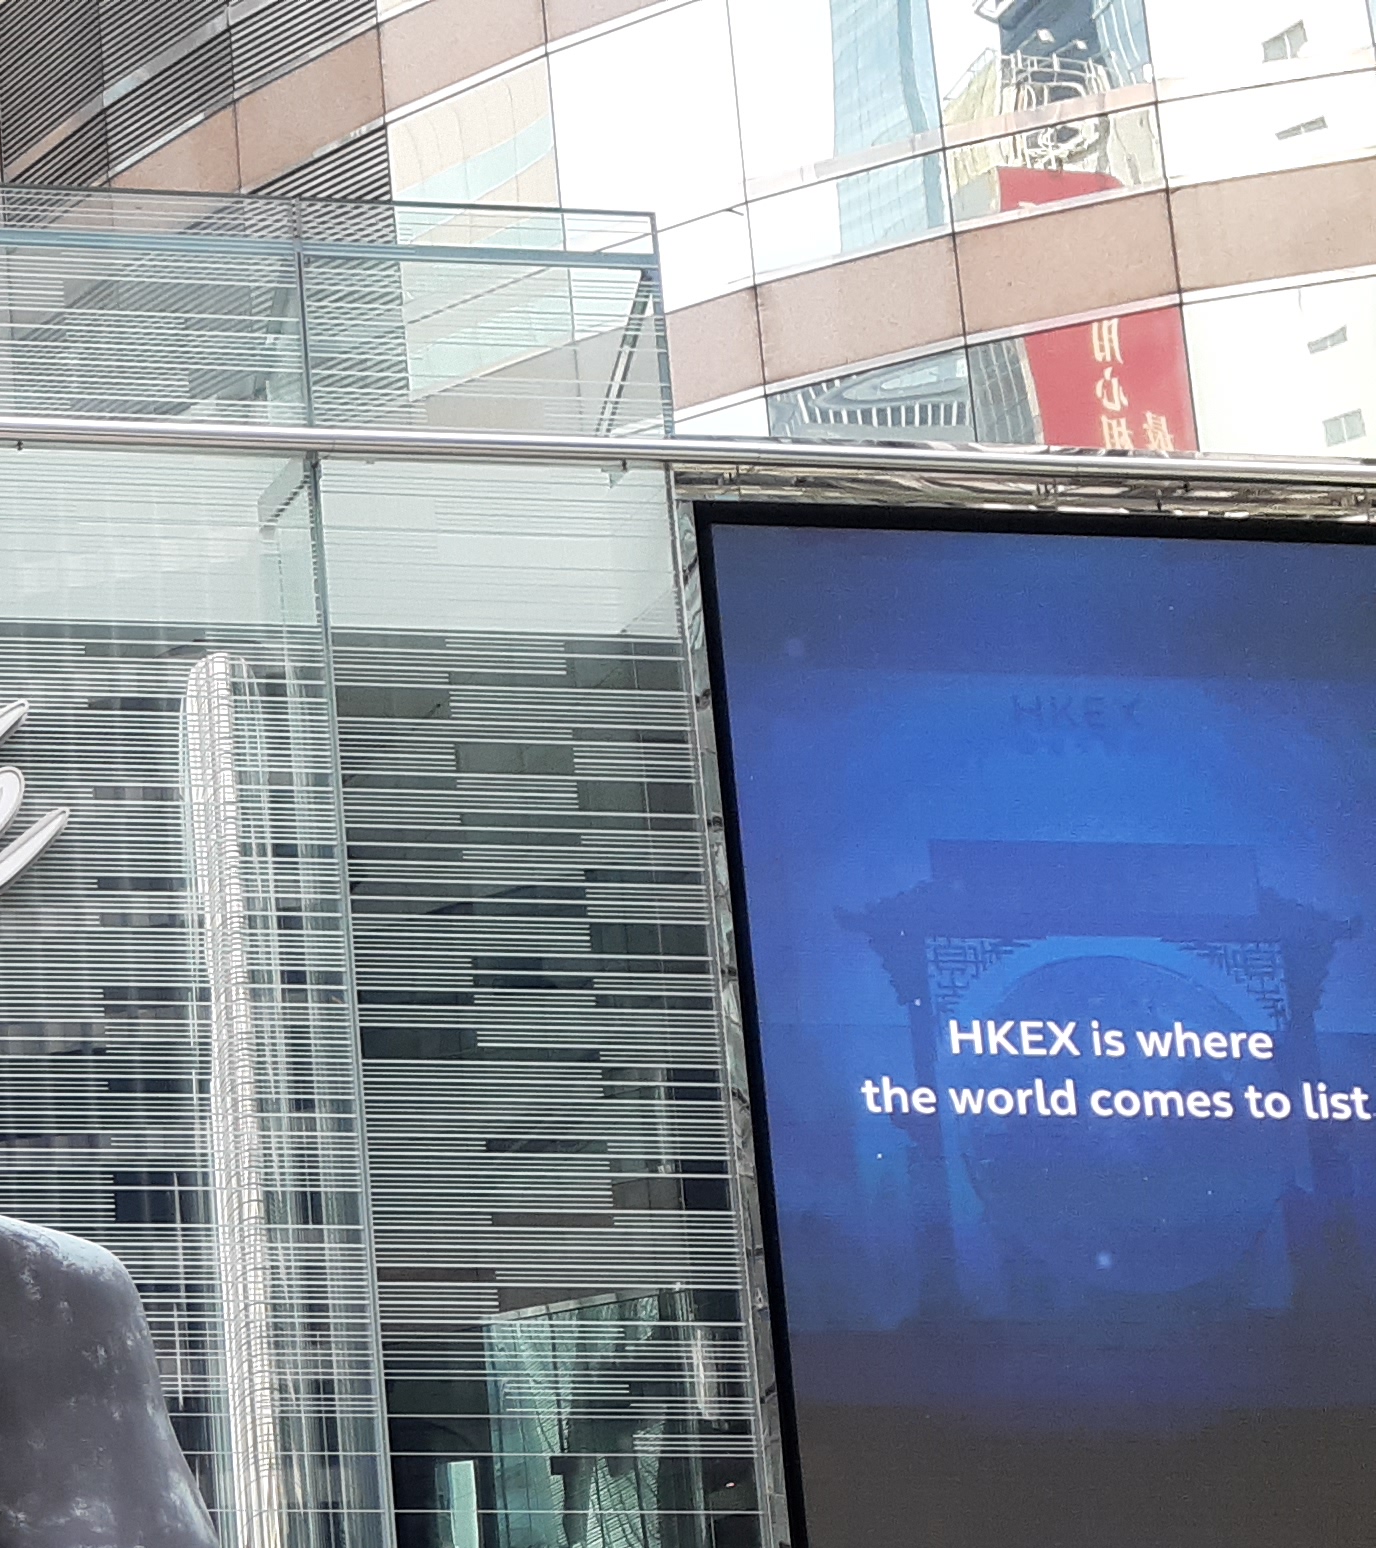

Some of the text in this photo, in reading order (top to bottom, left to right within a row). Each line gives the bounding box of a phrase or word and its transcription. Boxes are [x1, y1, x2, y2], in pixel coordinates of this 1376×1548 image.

[949, 1019, 1273, 1059] HKEX is where
[861, 1076, 937, 1114] the
[948, 1078, 1077, 1116] world
[1090, 1089, 1234, 1118] comes
[1244, 1085, 1291, 1119] to
